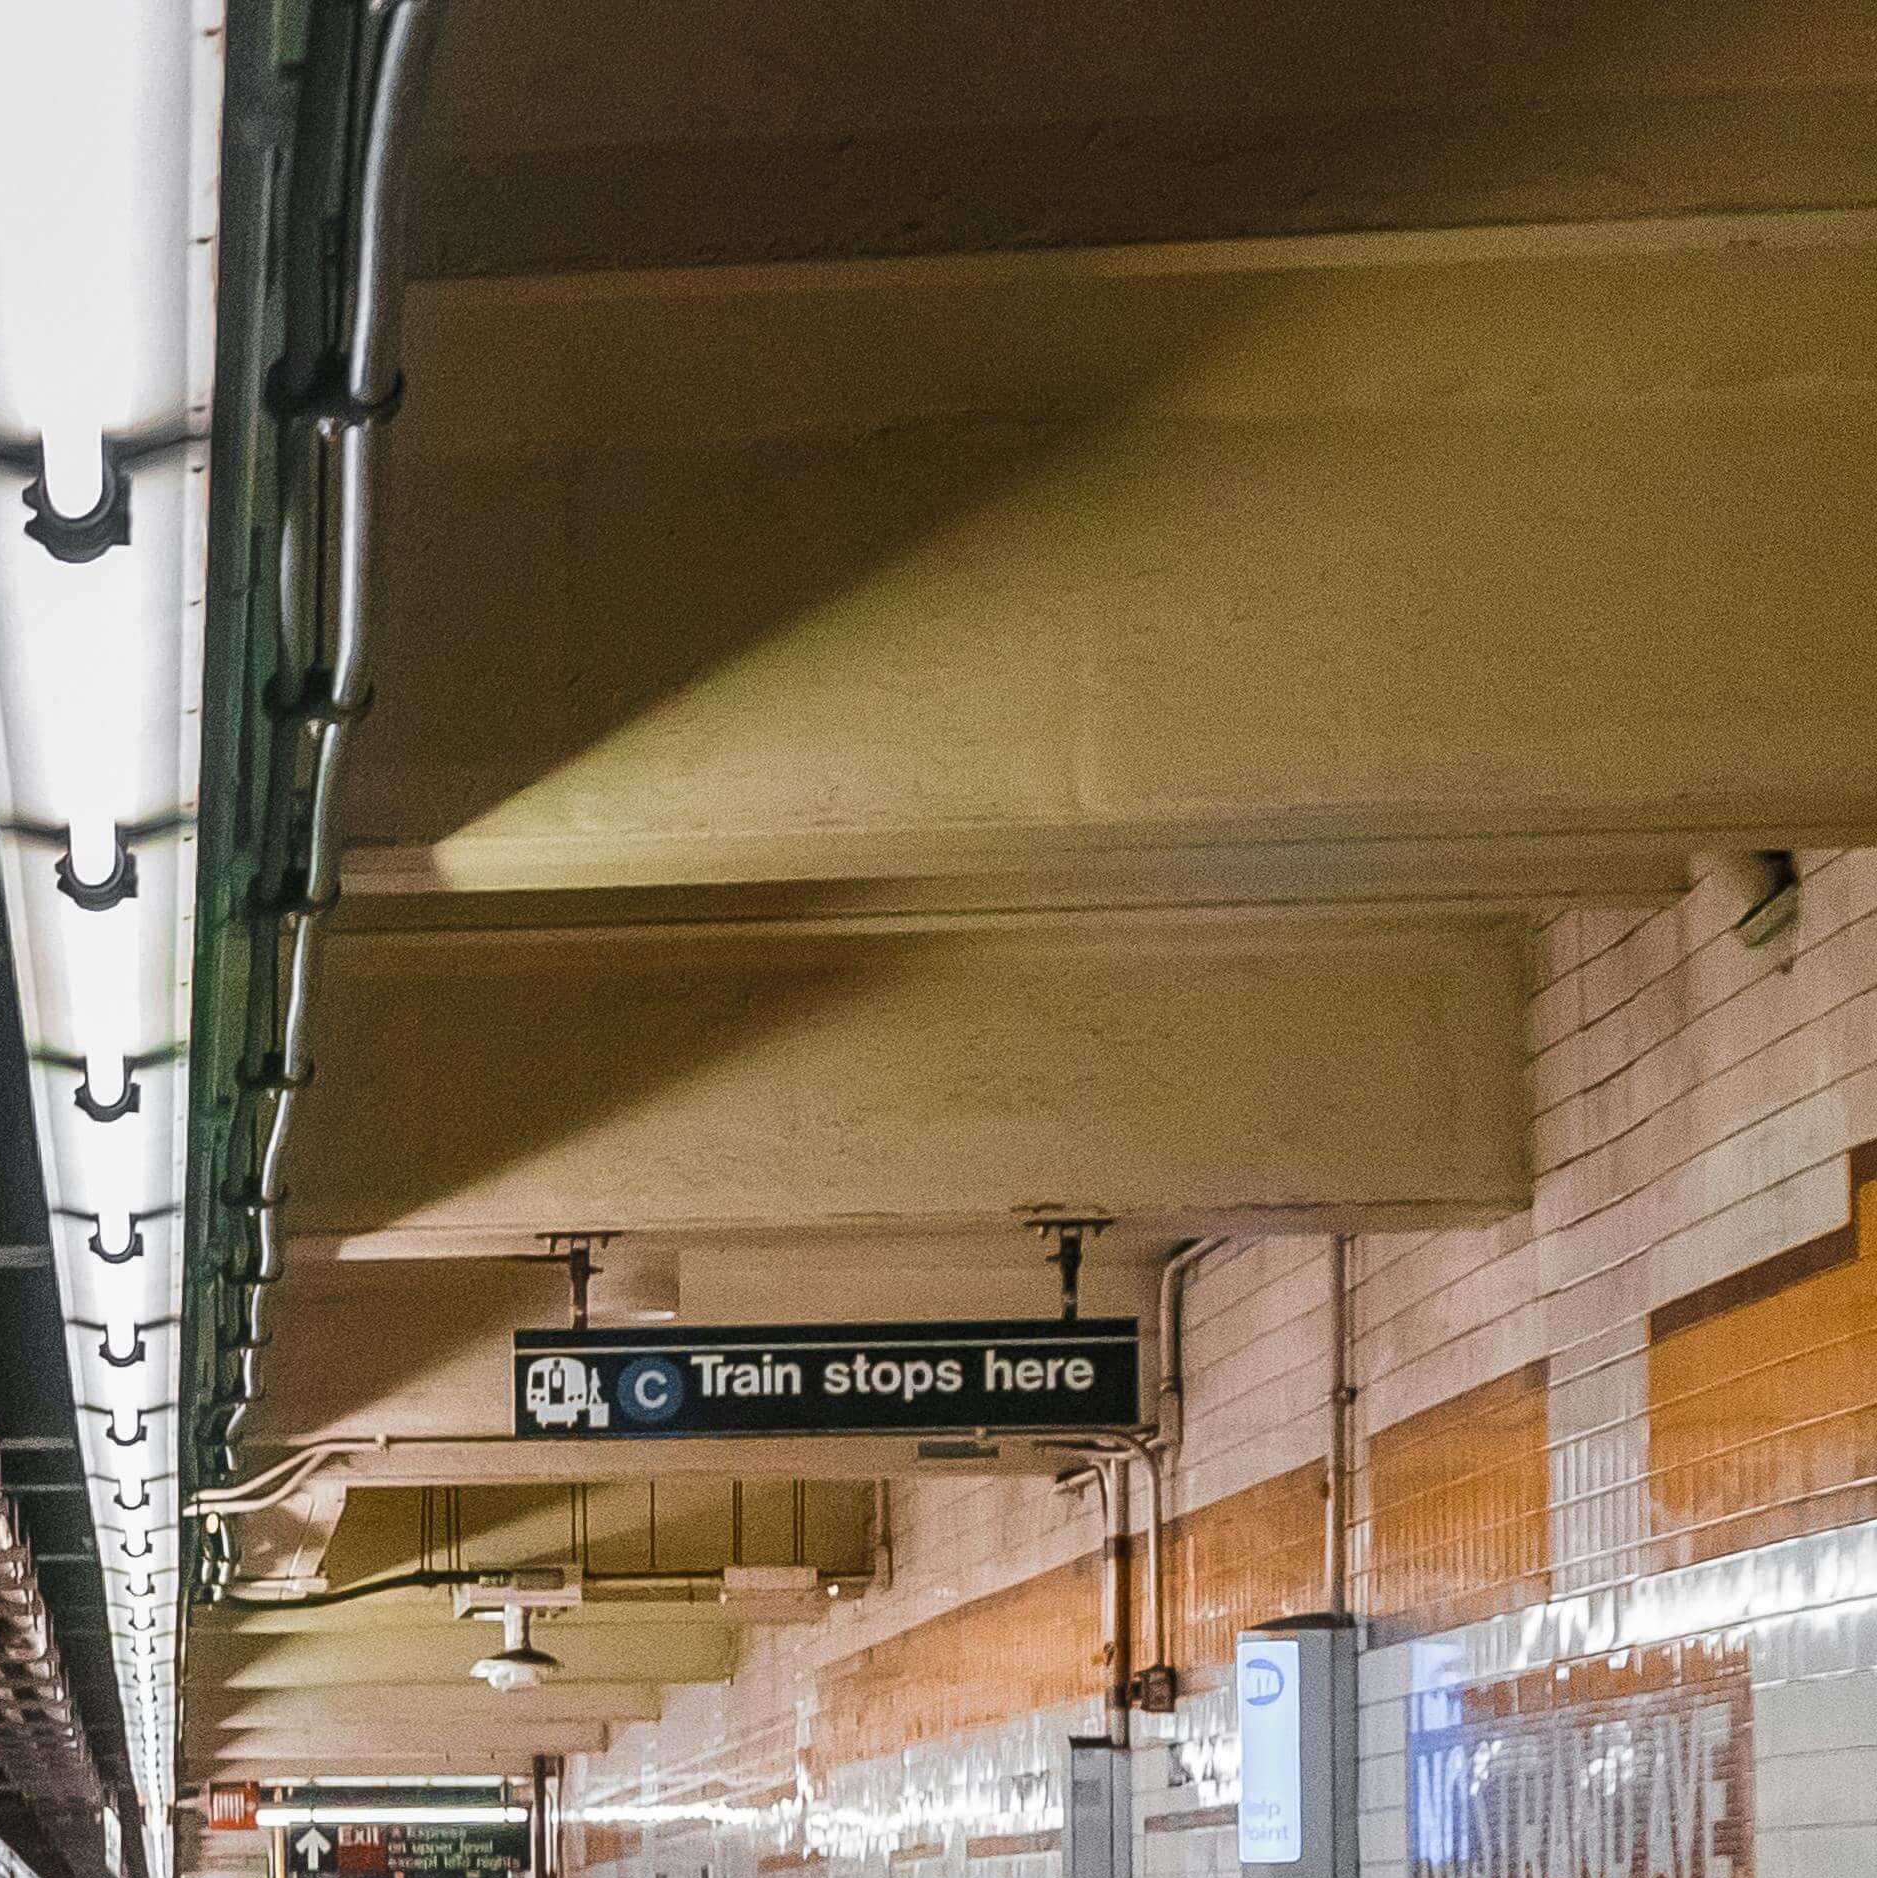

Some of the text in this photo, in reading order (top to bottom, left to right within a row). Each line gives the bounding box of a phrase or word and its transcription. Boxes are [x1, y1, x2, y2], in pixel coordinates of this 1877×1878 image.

[635, 1350, 1095, 1408] C Train stops here
[338, 1825, 380, 1847] Exit
